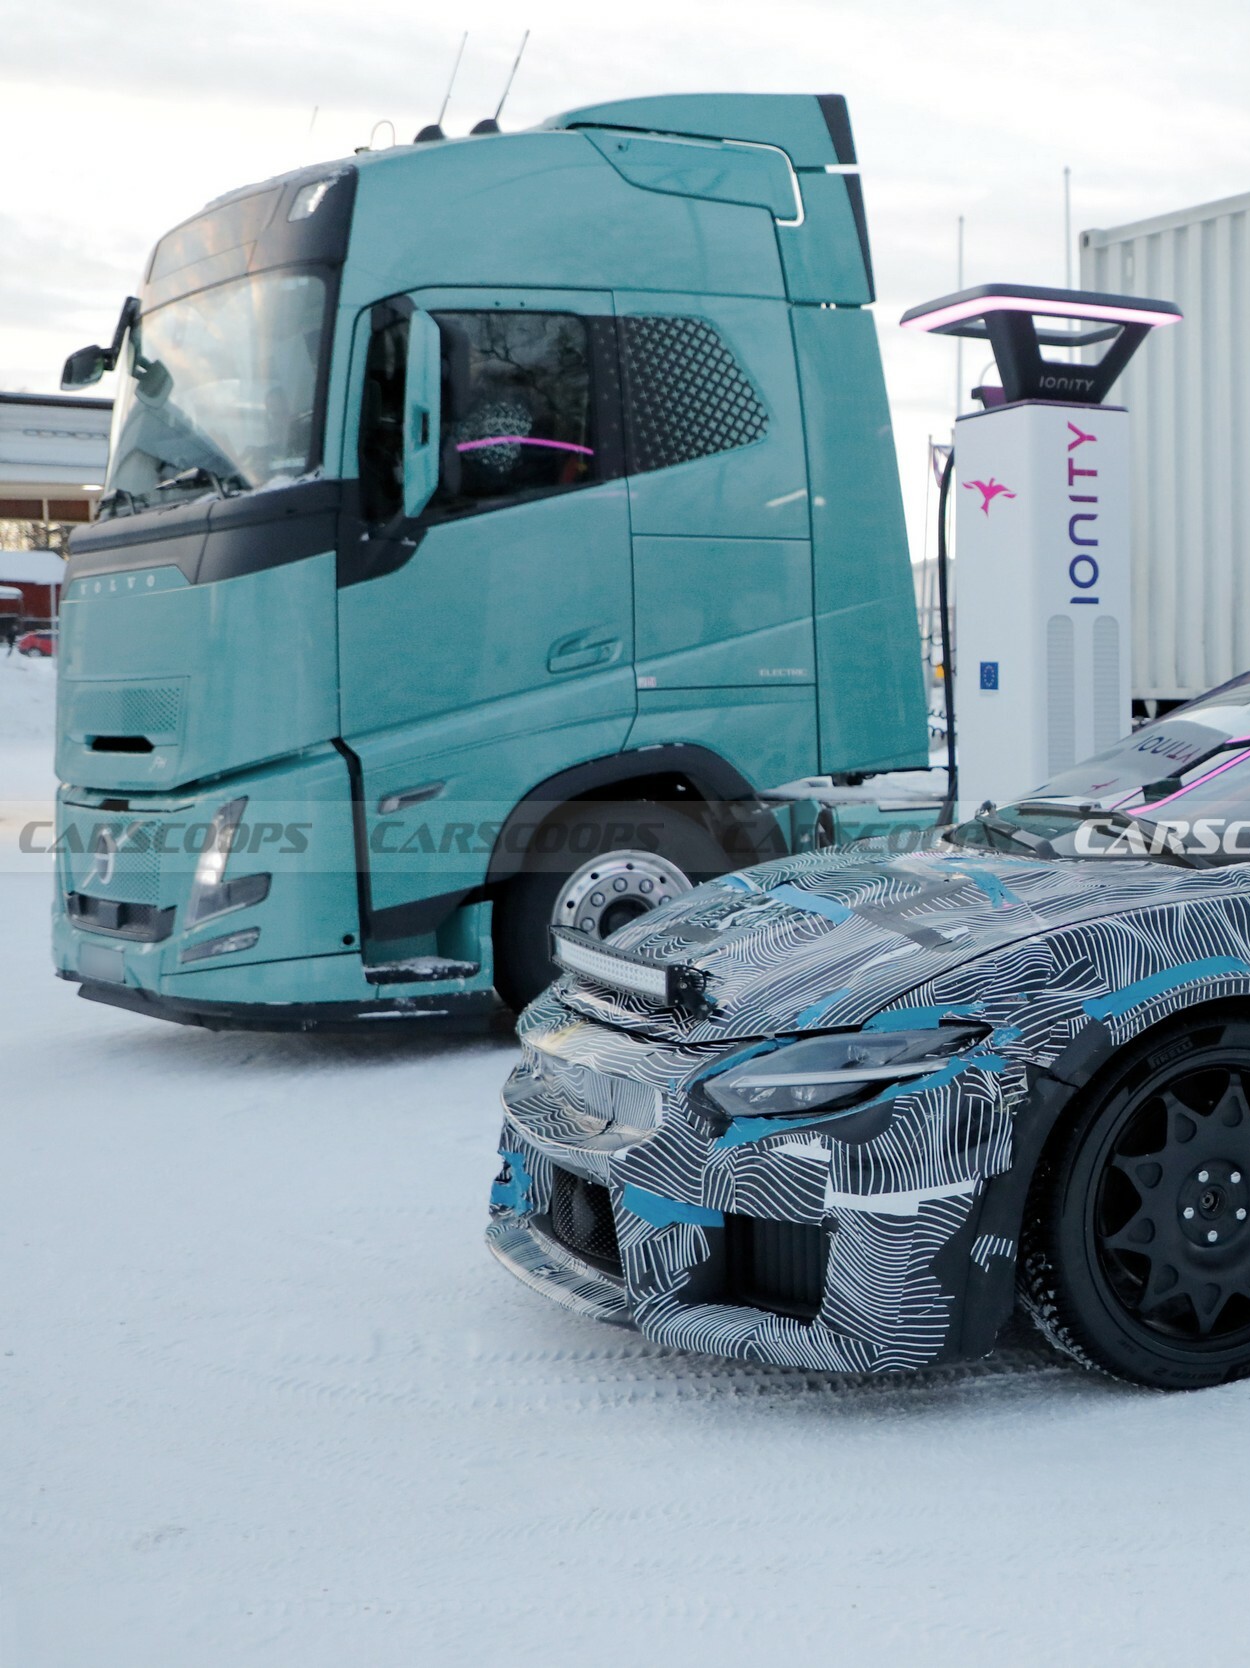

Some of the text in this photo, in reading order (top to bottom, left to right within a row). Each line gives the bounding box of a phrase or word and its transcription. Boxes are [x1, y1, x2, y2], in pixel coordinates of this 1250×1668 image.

[1039, 375, 1095, 392] IONITY
[1067, 421, 1100, 605] IONITY
[80, 574, 156, 596] VOLVO
